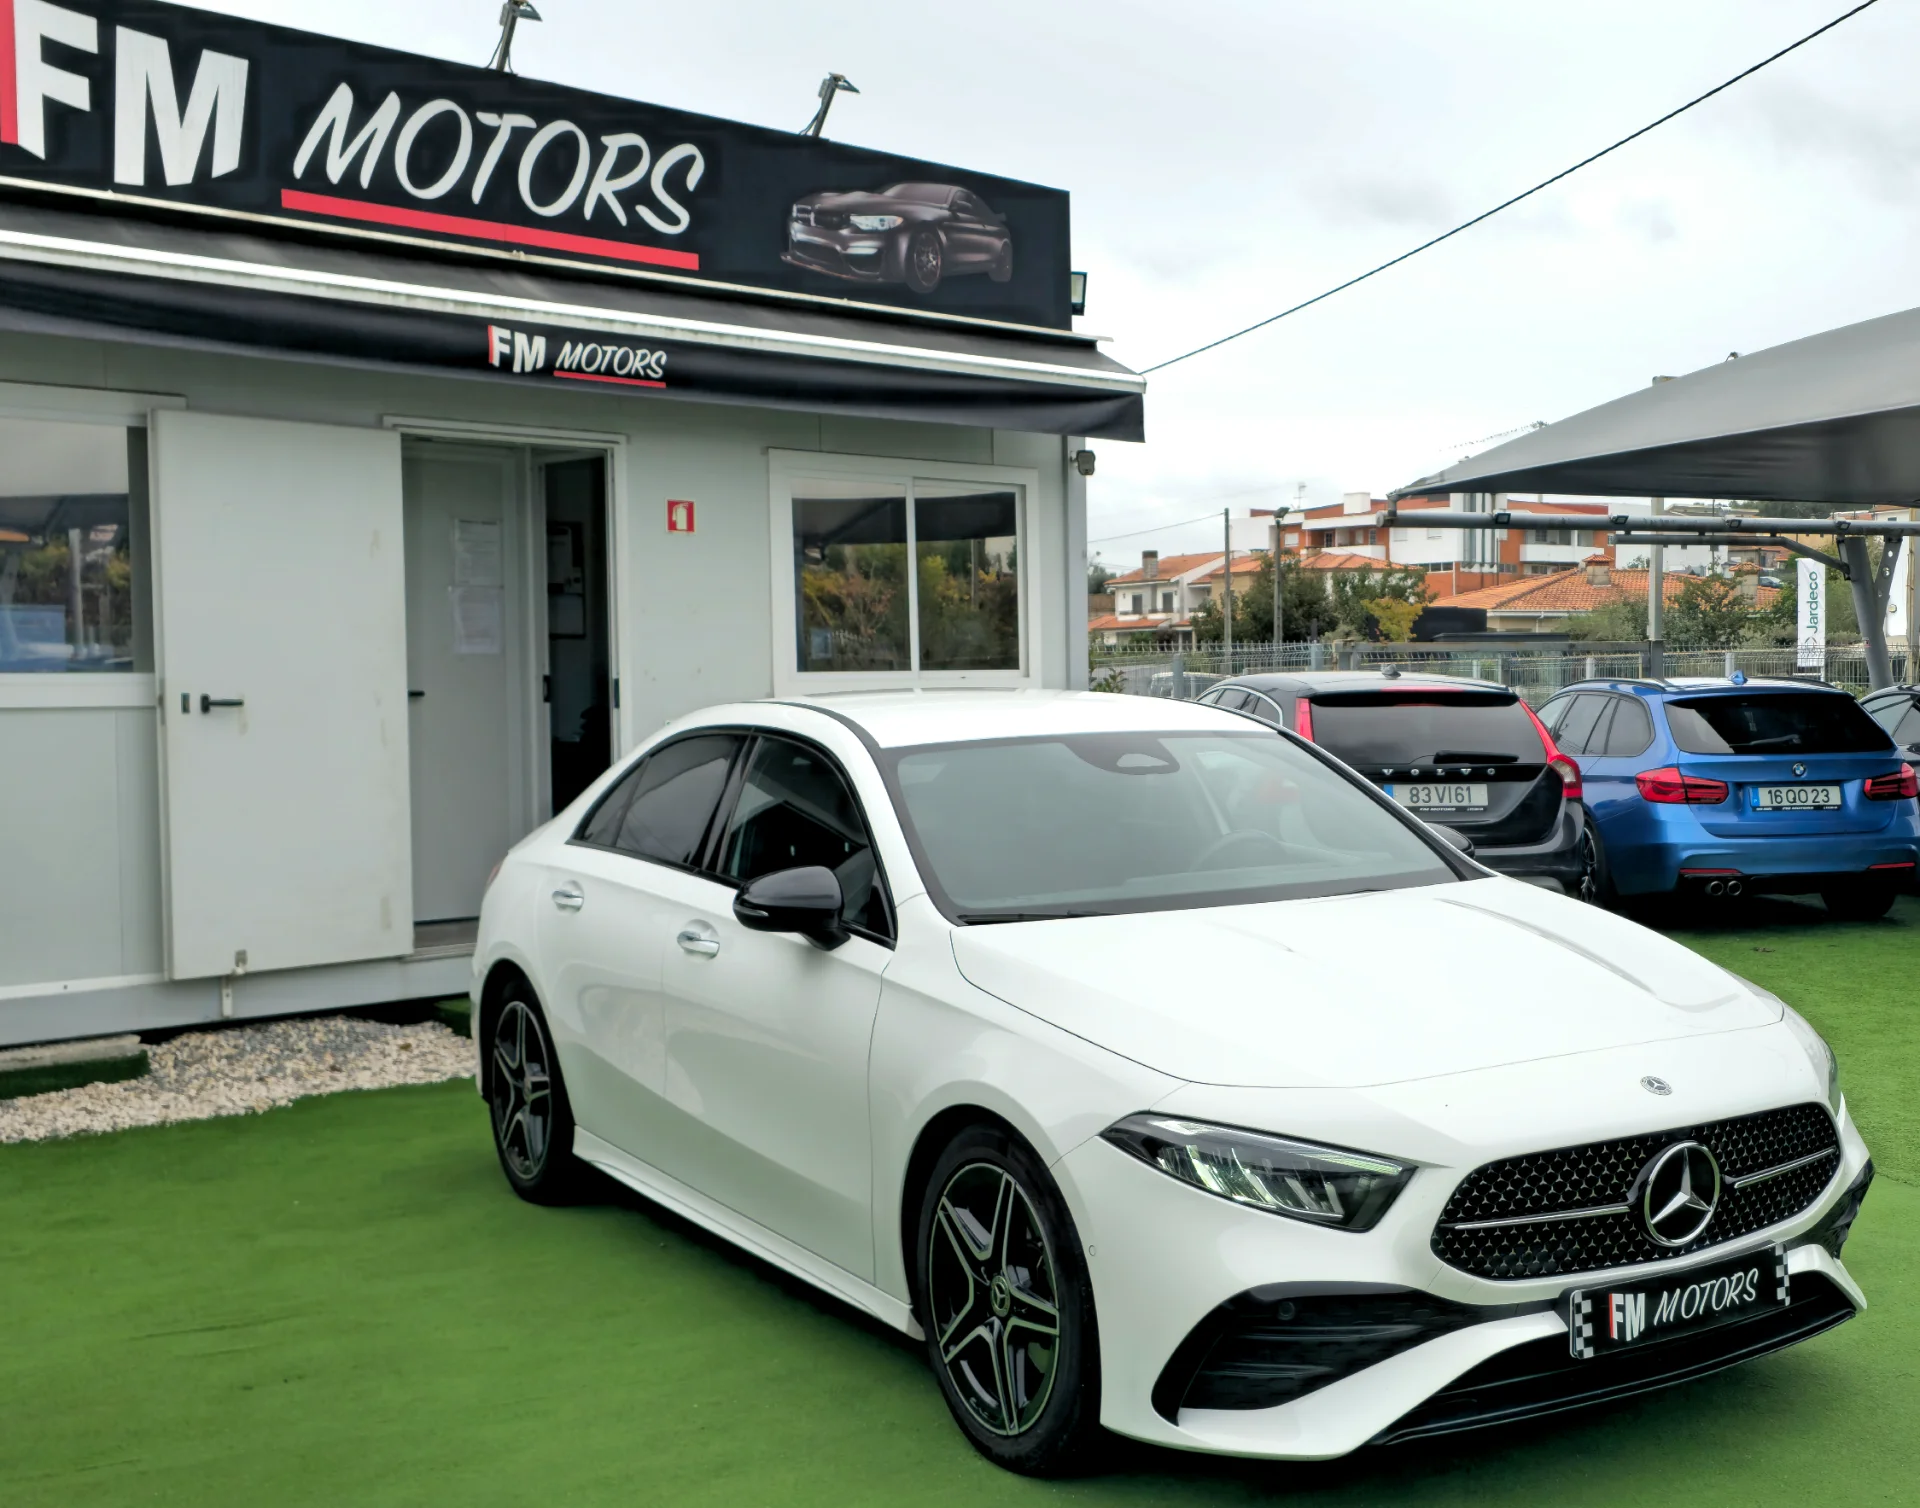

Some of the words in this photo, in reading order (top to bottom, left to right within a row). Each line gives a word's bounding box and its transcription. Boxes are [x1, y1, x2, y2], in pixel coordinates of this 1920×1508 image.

[5, 0, 249, 187] FM
[293, 82, 705, 236] MOTORS
[488, 325, 546, 373] FM
[555, 340, 667, 379] MOTORS
[1806, 571, 1819, 634] Jardeco
[1382, 768, 1496, 776] VOLVO
[1609, 1293, 1645, 1341] FM
[1654, 1268, 1758, 1326] MOTORS
